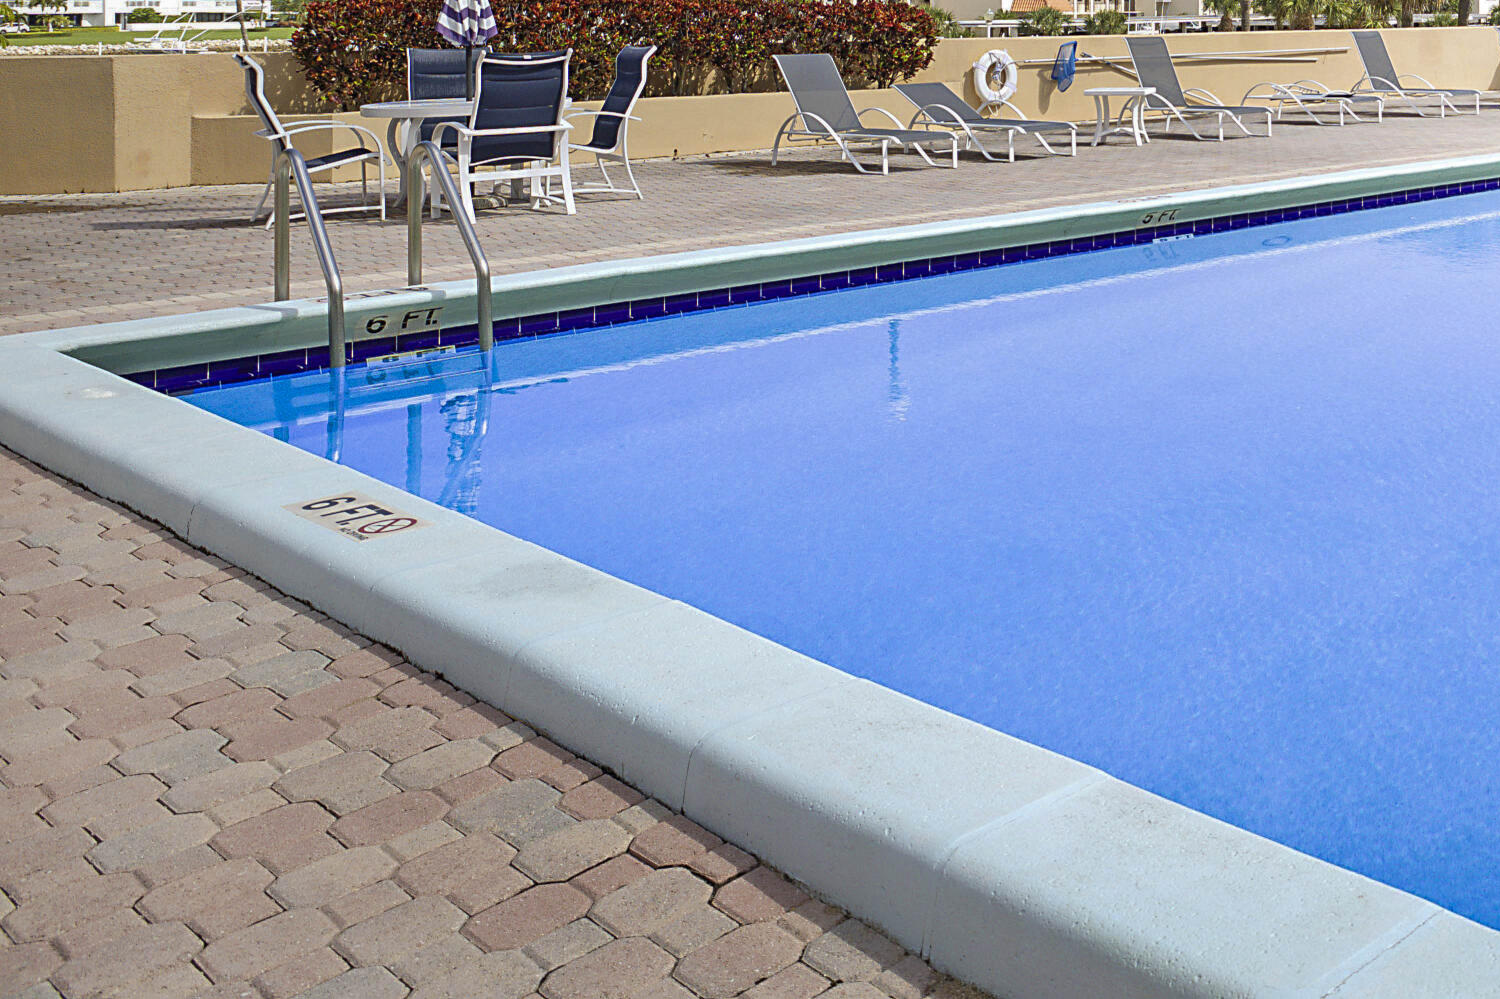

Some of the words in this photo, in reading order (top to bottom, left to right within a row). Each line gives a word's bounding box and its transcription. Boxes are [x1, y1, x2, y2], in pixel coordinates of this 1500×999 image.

[1142, 211, 1158, 225] 5
[366, 315, 389, 334] 6
[401, 306, 444, 329] FT.
[302, 496, 356, 511] 6
[320, 504, 394, 526] FT.
